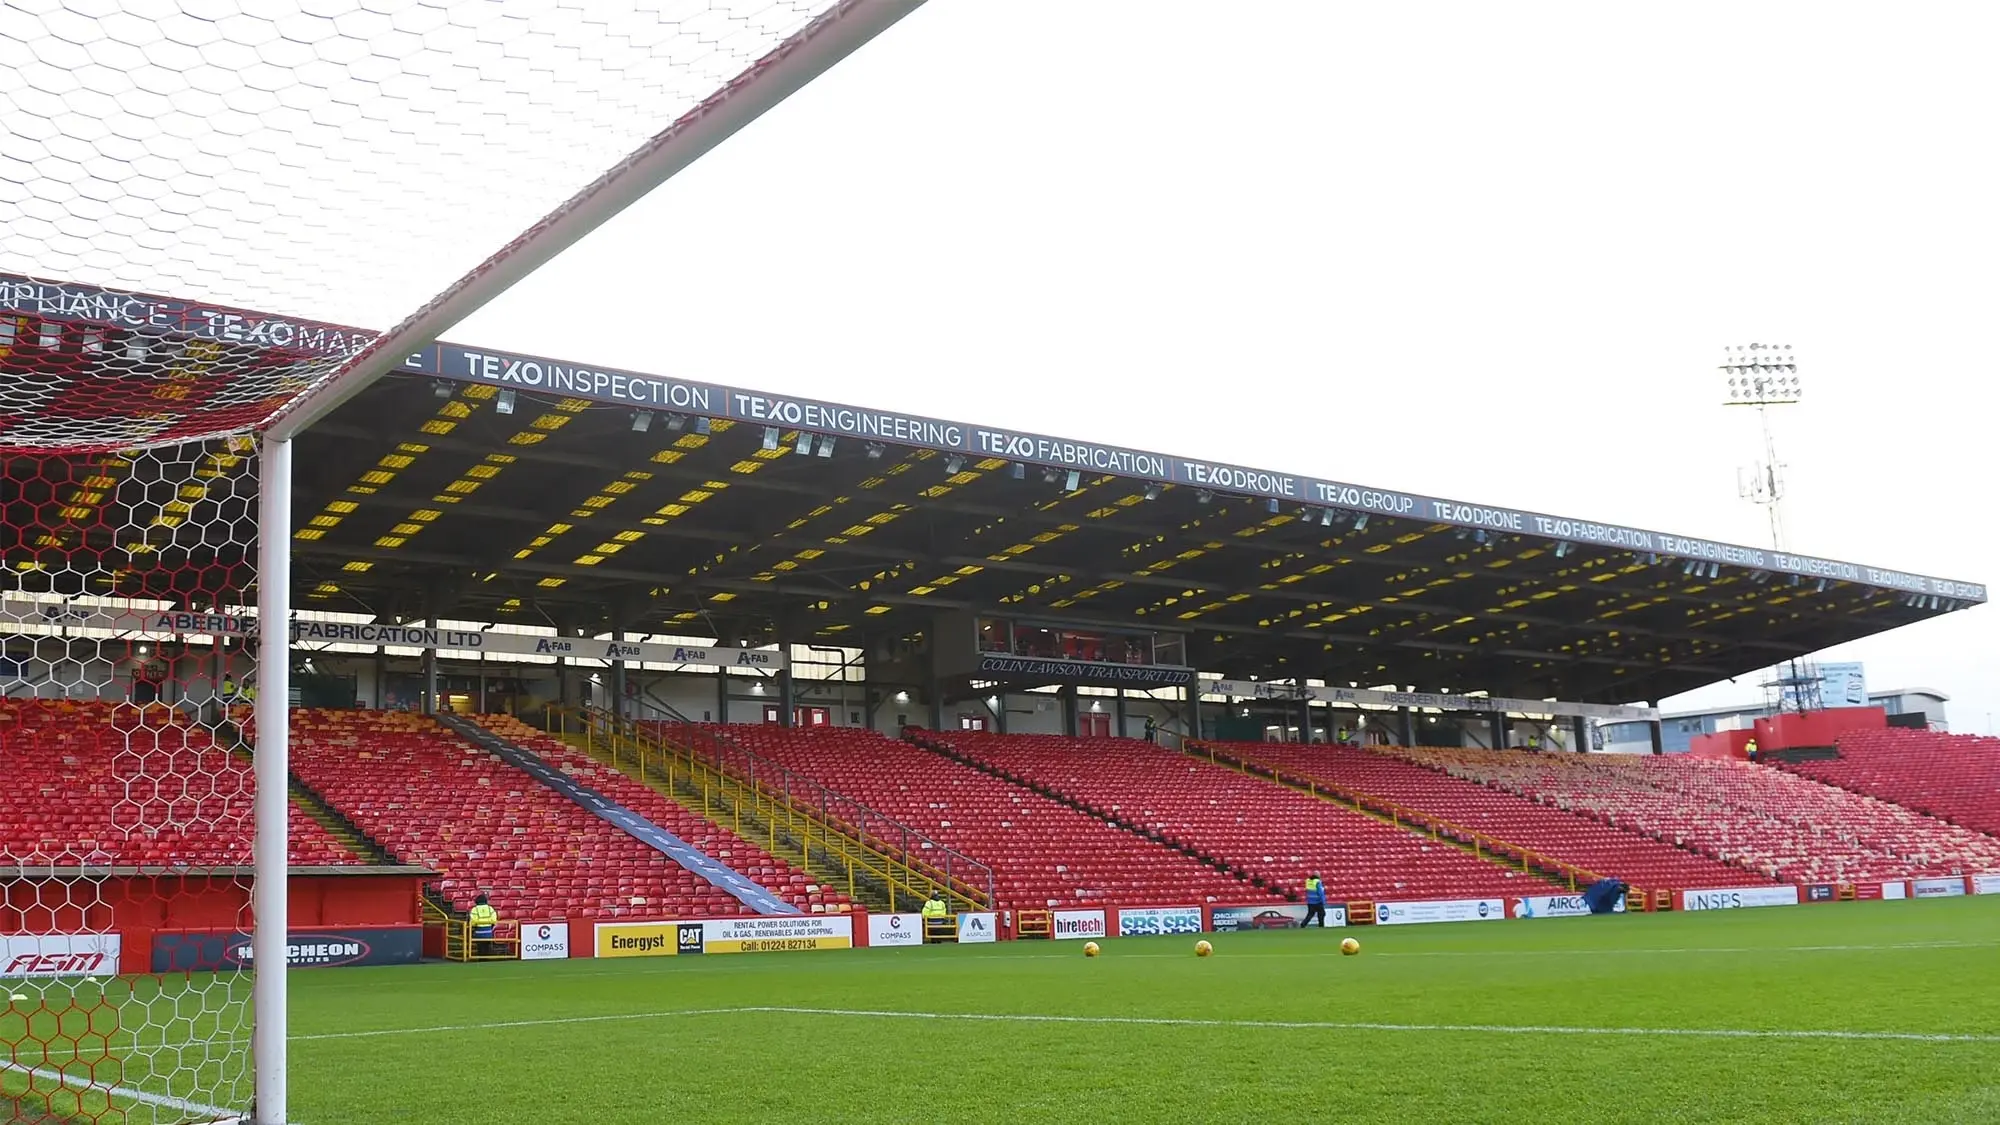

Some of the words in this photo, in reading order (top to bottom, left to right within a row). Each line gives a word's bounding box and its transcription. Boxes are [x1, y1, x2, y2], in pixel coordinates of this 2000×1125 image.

[297, 622, 438, 645] FABRICATION
[447, 632, 482, 647] LTD
[982, 659, 1024, 672] COLIN
[1027, 661, 1084, 676] LAWSON
[1087, 665, 1161, 681] TRANSPORT
[1163, 671, 1190, 683] LTD
[779, 920, 810, 928] SOLUTIONS
[1057, 918, 1100, 933] hiretech
[680, 929, 701, 944] CAT
[807, 928, 833, 936] SHIPPING
[880, 931, 911, 940] COMPASS
[525, 943, 564, 952] COMPASS
[612, 934, 664, 951] Energyst
[741, 941, 759, 952] Call:
[761, 941, 785, 950] 01224
[788, 940, 816, 949] 827134
[238, 943, 359, 959] HCHEON
